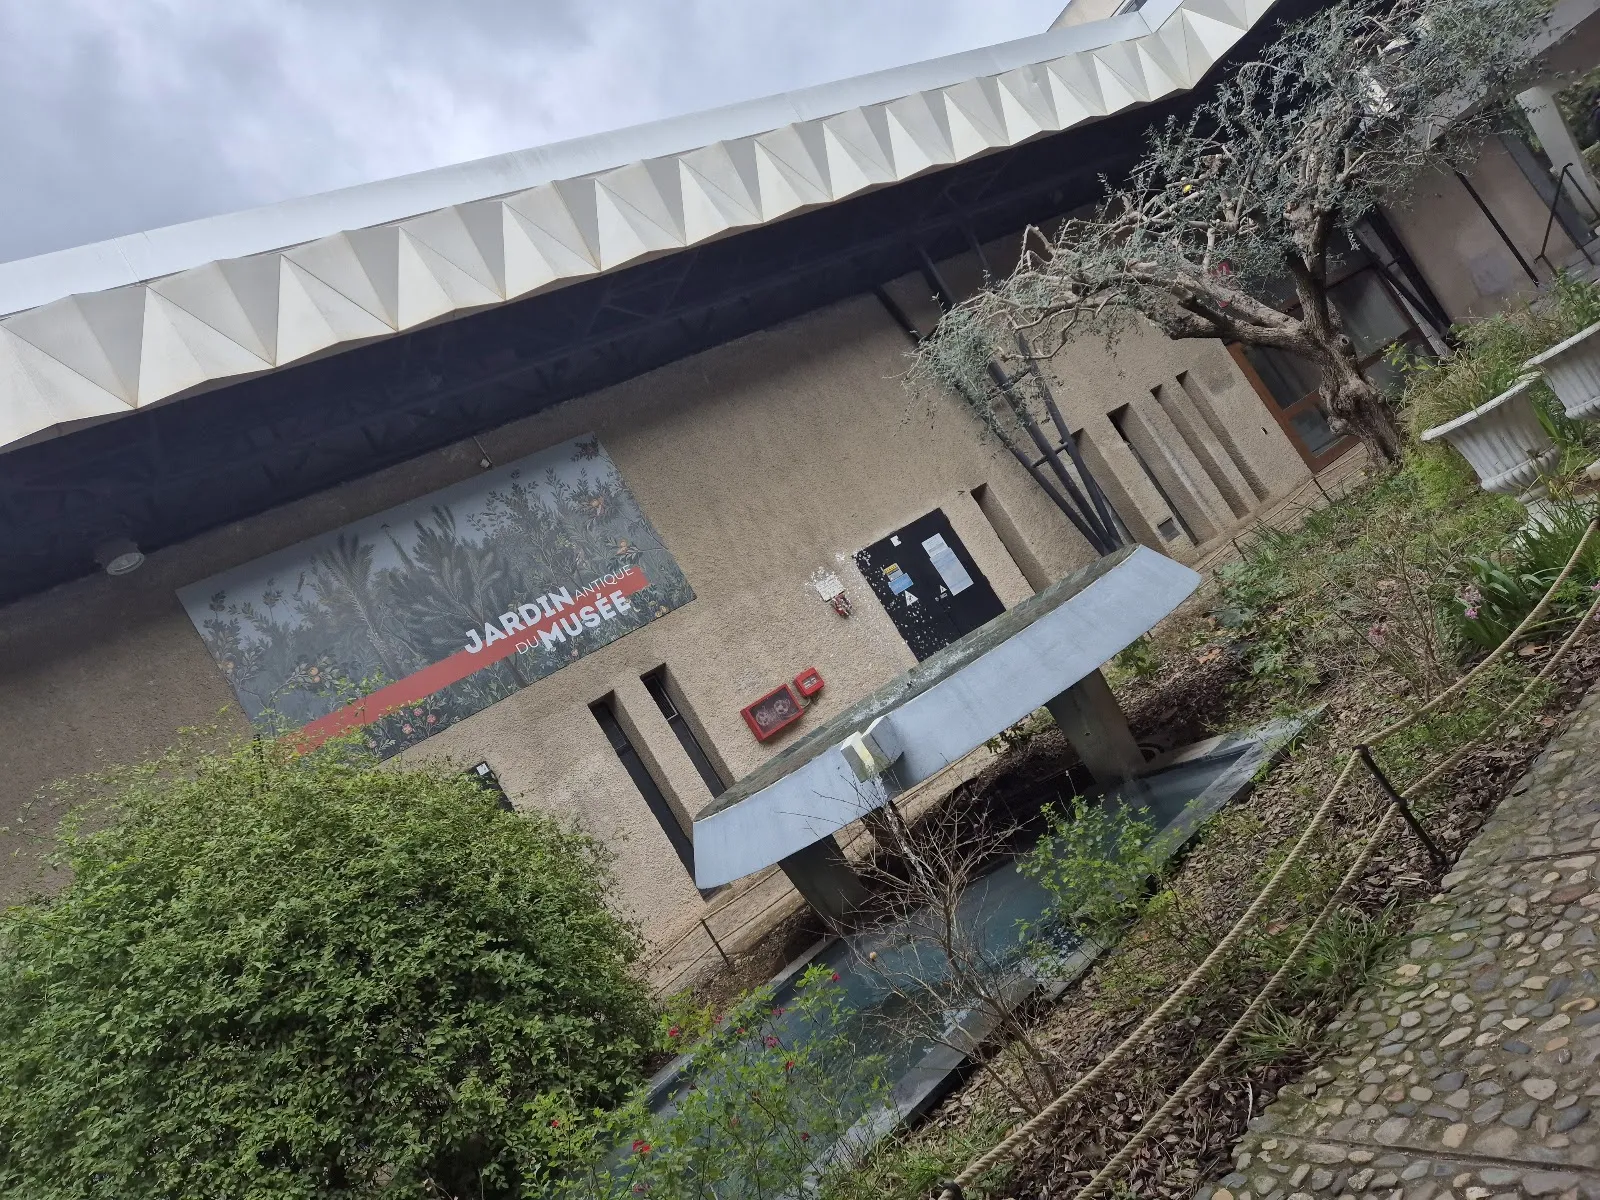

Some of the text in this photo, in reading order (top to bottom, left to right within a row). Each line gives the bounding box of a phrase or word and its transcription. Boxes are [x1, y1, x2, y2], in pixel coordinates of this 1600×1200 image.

[464, 565, 634, 653] JARDIN ANTIQUE
[515, 590, 631, 655] DU MUSÉE
